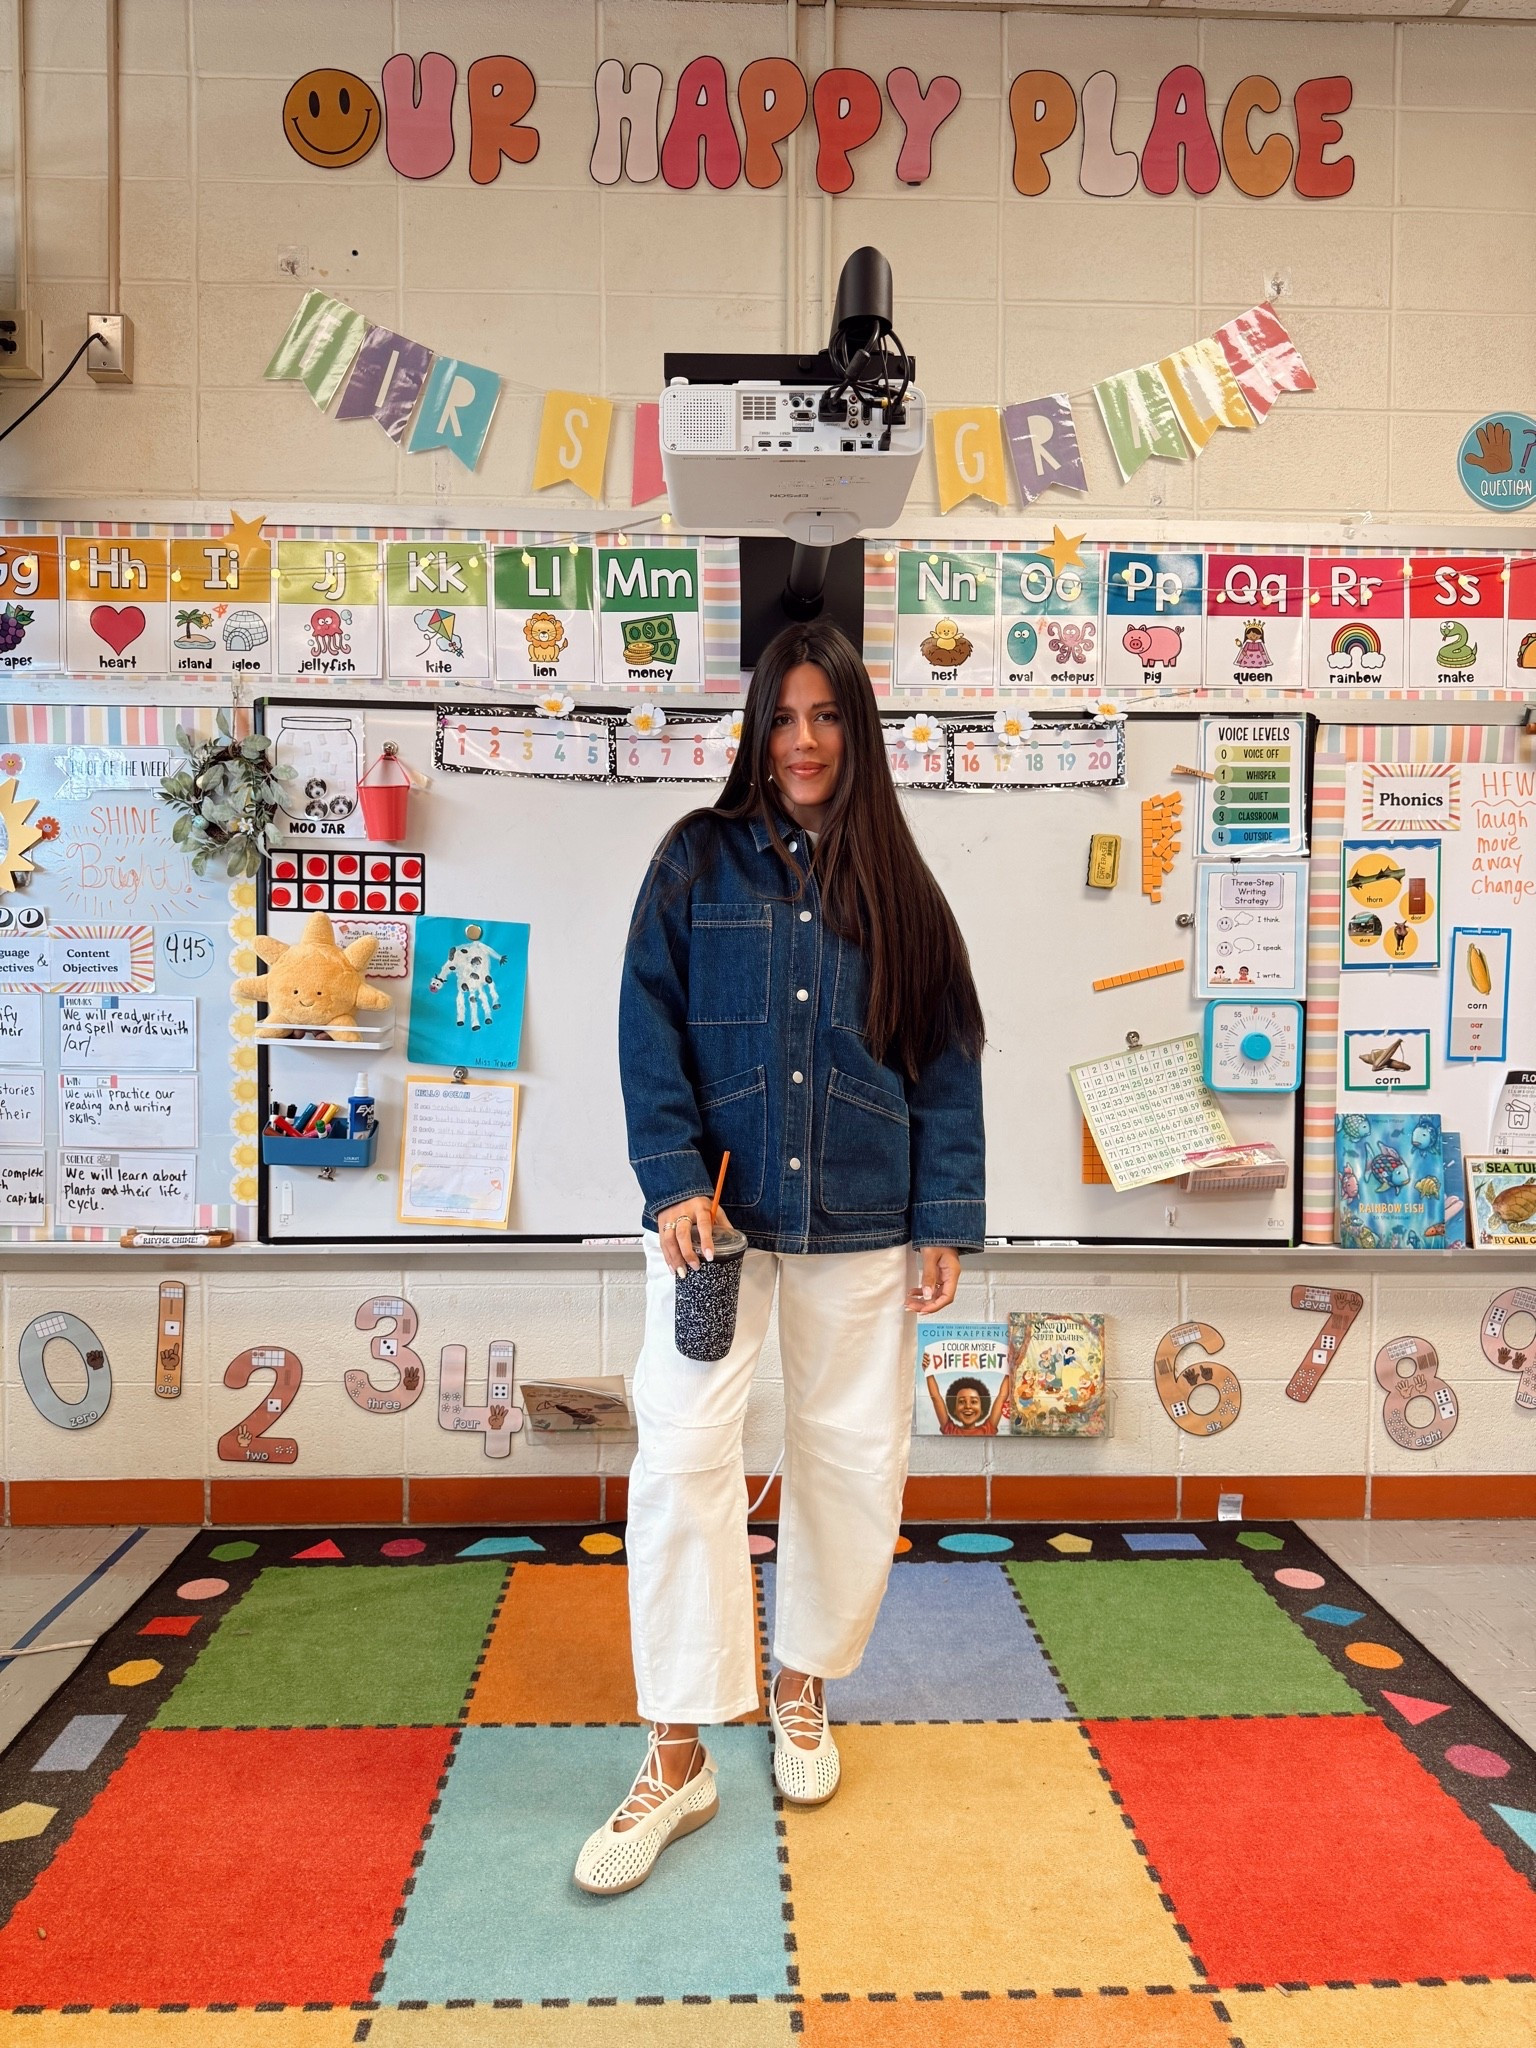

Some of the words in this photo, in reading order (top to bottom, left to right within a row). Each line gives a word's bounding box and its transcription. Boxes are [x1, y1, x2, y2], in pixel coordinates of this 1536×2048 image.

[589, 55, 961, 194] HAPPY
[1009, 64, 1355, 198] PLACE
[1480, 479, 1532, 497] QUESTION
[88, 547, 148, 589] Hh
[203, 547, 240, 590] Ii
[312, 550, 347, 601] Jj
[409, 551, 468, 593] Kk
[527, 555, 561, 598] Ll
[606, 557, 693, 599] Mm
[917, 561, 977, 602] Nn
[1020, 562, 1082, 603] Oo
[1126, 561, 1183, 612] Pp
[1224, 563, 1288, 613] Qq
[1331, 565, 1383, 607] Rr
[1433, 566, 1481, 606] Ss
[99, 655, 137, 669] heart
[178, 658, 212, 670] island
[232, 658, 261, 671] igloo
[298, 658, 356, 673] jellyfish
[425, 659, 452, 674] kite
[533, 664, 557, 678] lion
[628, 667, 673, 681] money
[931, 670, 958, 682] nest
[1009, 671, 1033, 682] oval
[1050, 671, 1095, 684] octopus
[1144, 671, 1162, 684] pig
[1233, 671, 1273, 684] queen
[1329, 671, 1382, 684] rainbow
[1437, 671, 1475, 683] snake
[1218, 727, 1249, 741] VOICE
[1253, 727, 1290, 741] LEVELS
[458, 738, 466, 755] 1
[489, 740, 501, 758] 2
[523, 742, 533, 761] 3
[554, 744, 566, 762] 4
[587, 746, 599, 765] 5
[628, 748, 640, 766] 6
[661, 748, 671, 766] 7
[693, 748, 705, 766] 8
[1221, 749, 1227, 759] 0
[1243, 749, 1264, 759] VOICE
[1266, 749, 1280, 759] OFF
[140, 761, 169, 777] WEEK
[923, 755, 941, 773] 15
[962, 754, 980, 773] 16
[1026, 753, 1044, 772] 18
[1057, 753, 1076, 771] 19
[1088, 752, 1111, 770] 20
[1221, 769, 1226, 780] 1
[1246, 771, 1277, 780] WHISPER
[1482, 771, 1536, 798] HFW
[1220, 790, 1226, 801] 2
[1248, 791, 1269, 801] QUIET
[1379, 792, 1444, 807] Phonics
[90, 806, 162, 835] SHINE
[1219, 811, 1225, 822] 3
[1238, 811, 1279, 821] CLASSROOM
[1476, 808, 1528, 836] laugh
[289, 822, 316, 834] MOO
[321, 823, 346, 835] JAR
[1218, 832, 1224, 842] 4
[1243, 832, 1273, 841] OUTSIDE
[1477, 836, 1521, 854] move
[1471, 853, 1523, 872] away
[1231, 879, 1274, 887] Three-Step
[1471, 874, 1536, 905] change
[1238, 889, 1266, 897] Writing
[1235, 897, 1268, 905] Strategy
[66, 949, 110, 958] Content
[62, 963, 119, 973] Objectives
[1467, 1002, 1488, 1010] corn
[63, 1008, 81, 1021] We
[86, 1008, 106, 1021] will
[62, 1023, 82, 1031] and
[84, 1021, 114, 1036] spell
[120, 1021, 158, 1036] words
[161, 1020, 189, 1036] with
[1375, 1077, 1401, 1085] corn
[65, 1089, 81, 1099] We
[84, 1089, 102, 1098] will
[108, 1088, 150, 1102] practice
[155, 1090, 175, 1099] our
[64, 1101, 102, 1116] reading
[108, 1101, 130, 1112] and
[134, 1103, 171, 1116] writing
[66, 1155, 94, 1164] SCIENCE
[66, 1168, 84, 1180] We
[91, 1167, 113, 1180] will
[117, 1168, 148, 1181] learn
[152, 1168, 188, 1182] about
[1486, 1162, 1512, 1174] SEA
[64, 1184, 96, 1198] plants
[101, 1184, 118, 1196] and
[121, 1184, 152, 1197] their
[1358, 1203, 1402, 1214] RAINBOW
[1404, 1203, 1425, 1214] FISH
[143, 1236, 170, 1245] RHYME
[172, 1235, 199, 1244] CHIME!
[1493, 1236, 1506, 1245] BY
[1507, 1235, 1528, 1245] GAIL
[1299, 1299, 1332, 1312] seven
[947, 1343, 969, 1351] COLOR
[971, 1343, 996, 1351] MYSELF
[1285, 1284, 1364, 1403] 7
[1480, 1287, 1536, 1409] 9
[344, 1295, 426, 1414] 3
[933, 1353, 1006, 1369] DIFFERENT
[1154, 1321, 1242, 1436] 6
[157, 1384, 180, 1395] one
[1374, 1336, 1459, 1451] 8
[217, 1345, 303, 1464] 2
[367, 1398, 401, 1410] three
[438, 1339, 524, 1459] 4
[70, 1410, 98, 1427] zero
[452, 1417, 481, 1430] four
[1206, 1420, 1222, 1433] six
[1415, 1428, 1444, 1447] eight
[245, 1449, 269, 1461] two
